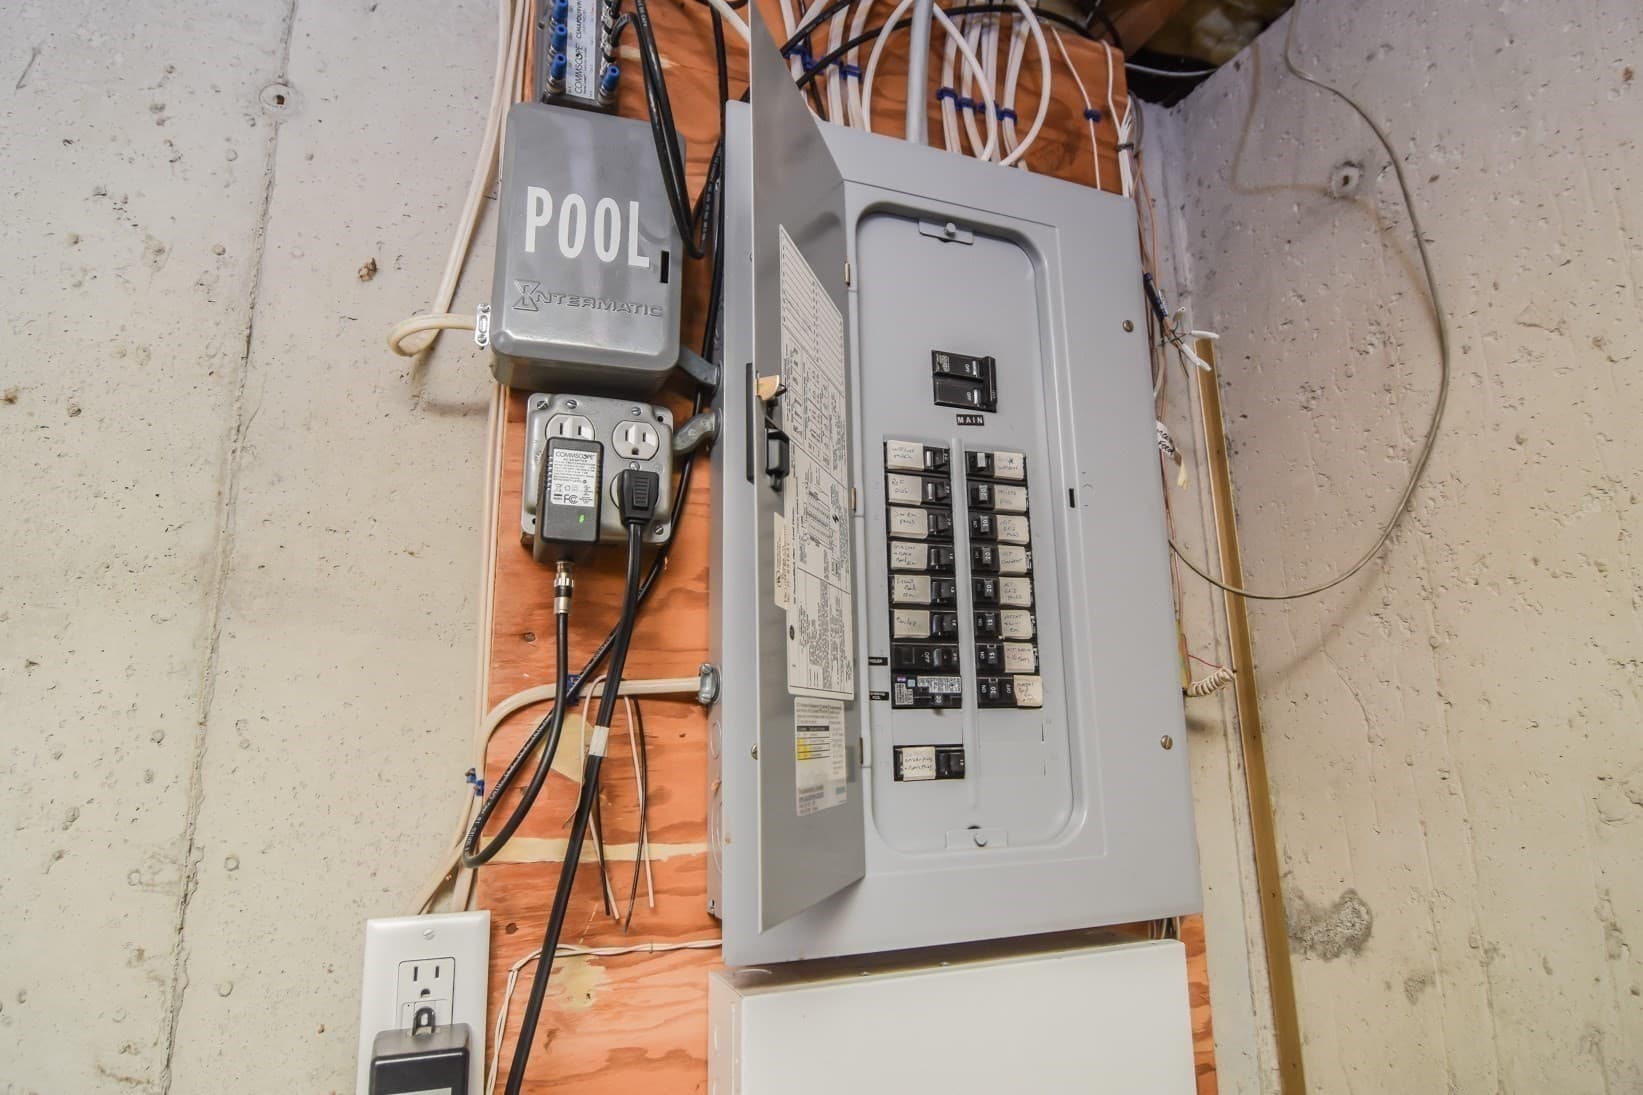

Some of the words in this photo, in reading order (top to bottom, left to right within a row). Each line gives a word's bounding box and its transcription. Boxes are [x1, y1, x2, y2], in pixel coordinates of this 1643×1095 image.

[574, 43, 584, 94] COMMSCOPE
[524, 185, 650, 268] POOL
[957, 416, 984, 425] MAIN
[555, 451, 595, 460] COMMSCOPE
